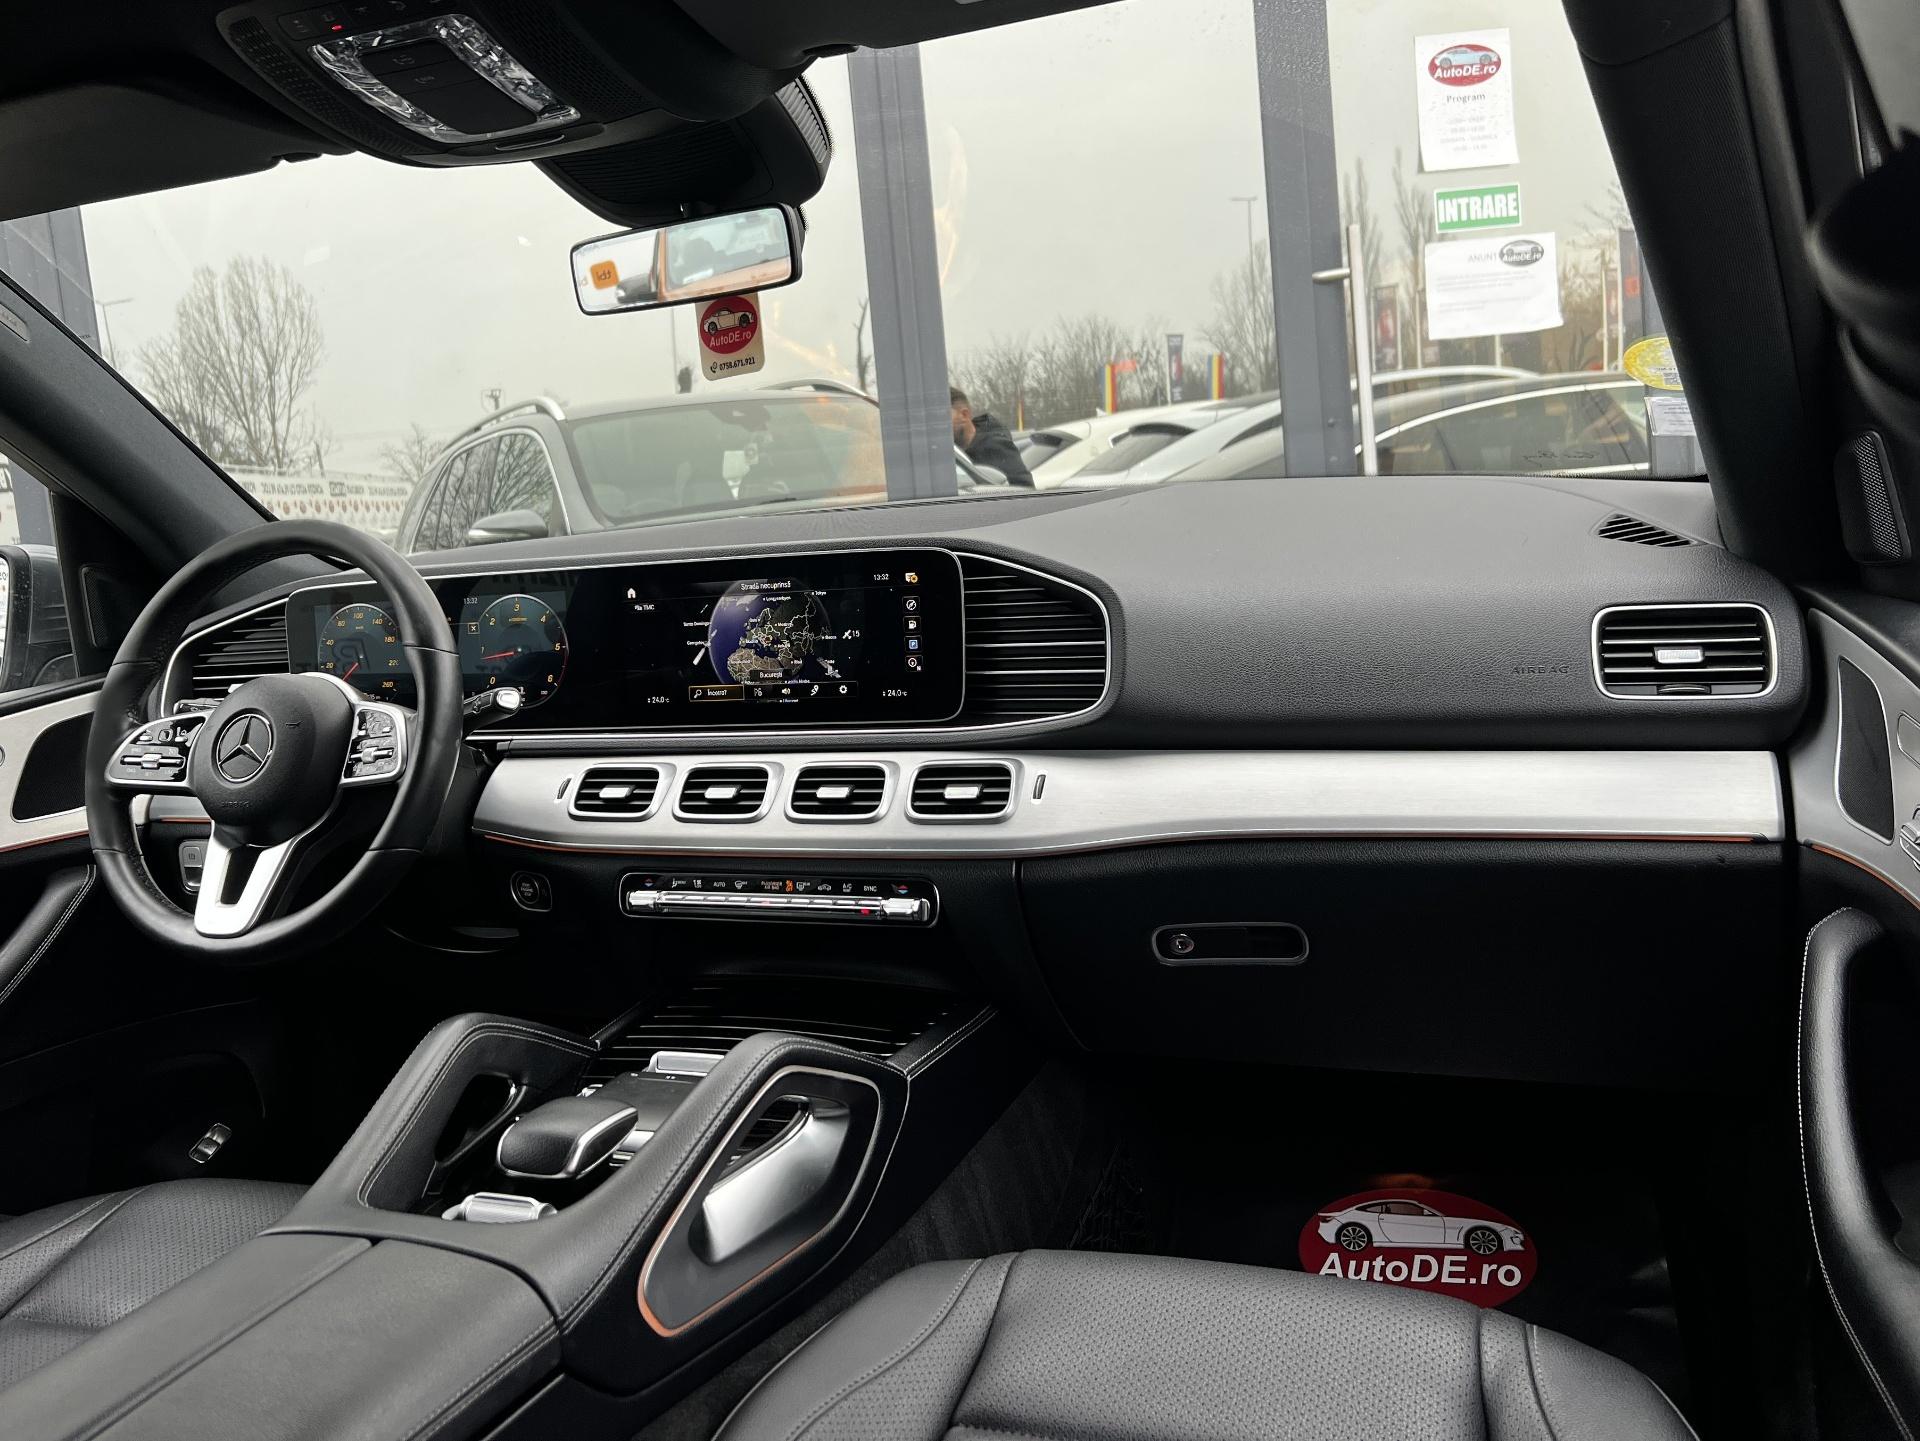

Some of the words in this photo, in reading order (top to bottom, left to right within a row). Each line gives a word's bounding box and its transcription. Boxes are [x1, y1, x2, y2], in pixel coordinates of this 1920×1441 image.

[1434, 65, 1497, 79] AutoDE.ro
[1446, 93, 1486, 104] Program
[1437, 191, 1519, 224] INTRARE
[709, 330, 752, 347] AutoDE.ro
[719, 357, 756, 371] 0758.671.921
[873, 573, 889, 581] 13:32
[489, 617, 496, 626] 2
[852, 629, 860, 638] 15
[1510, 664, 1570, 675] AIRBAG
[489, 676, 496, 685] 0
[547, 674, 553, 682] 6
[1318, 1252, 1522, 1287] AutoDE.ro
